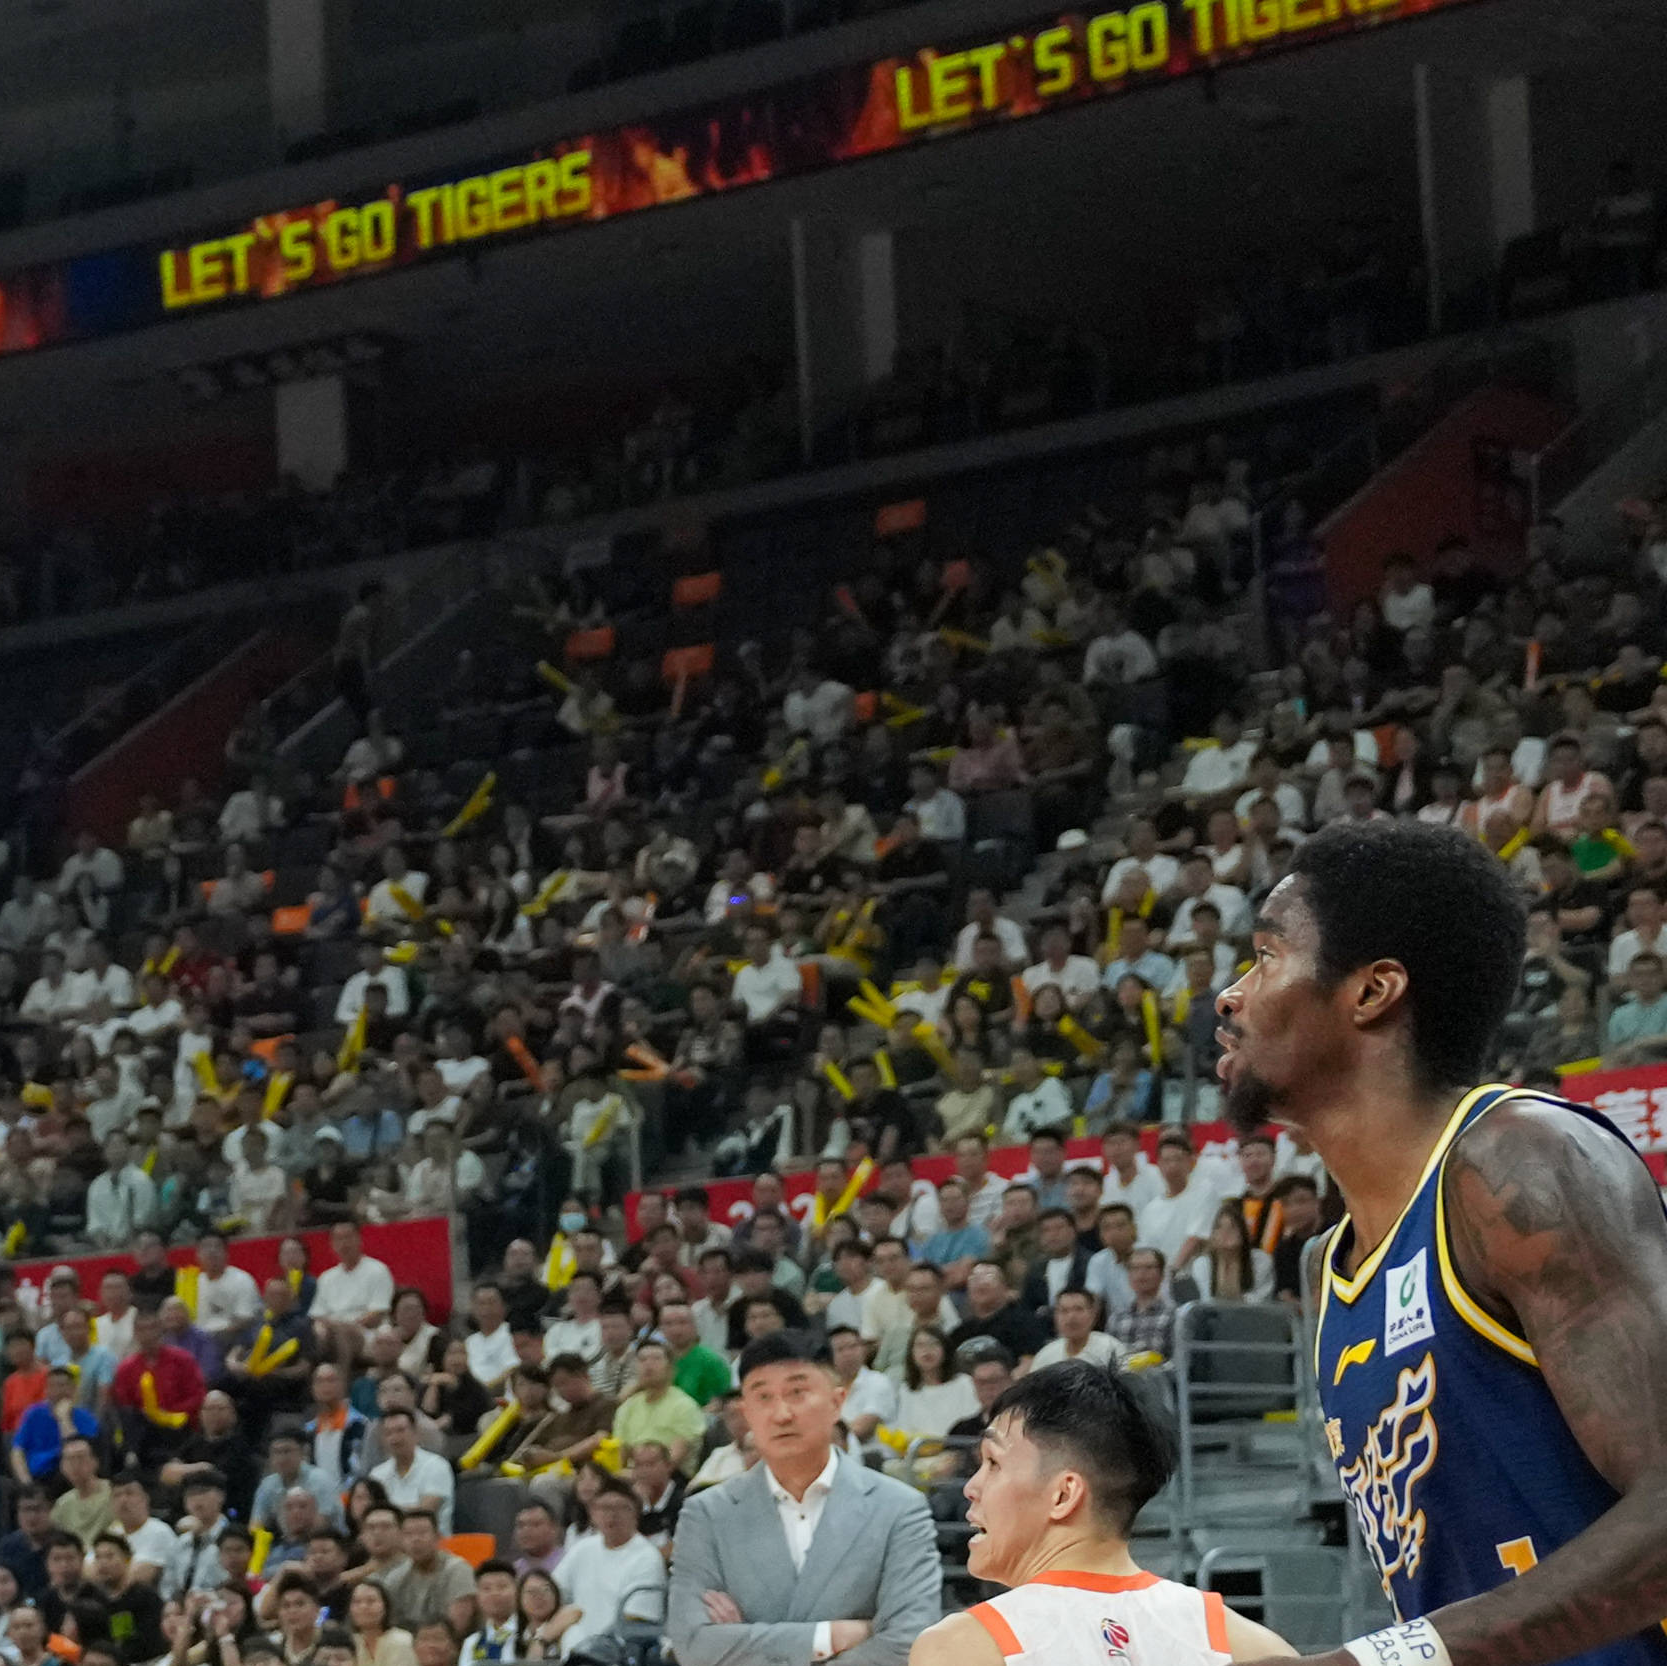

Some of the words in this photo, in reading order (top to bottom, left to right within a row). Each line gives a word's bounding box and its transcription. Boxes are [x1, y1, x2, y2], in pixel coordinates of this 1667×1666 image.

[1087, 1, 1167, 82] GO
[325, 200, 397, 270] GO
[407, 149, 593, 250] TIGERS
